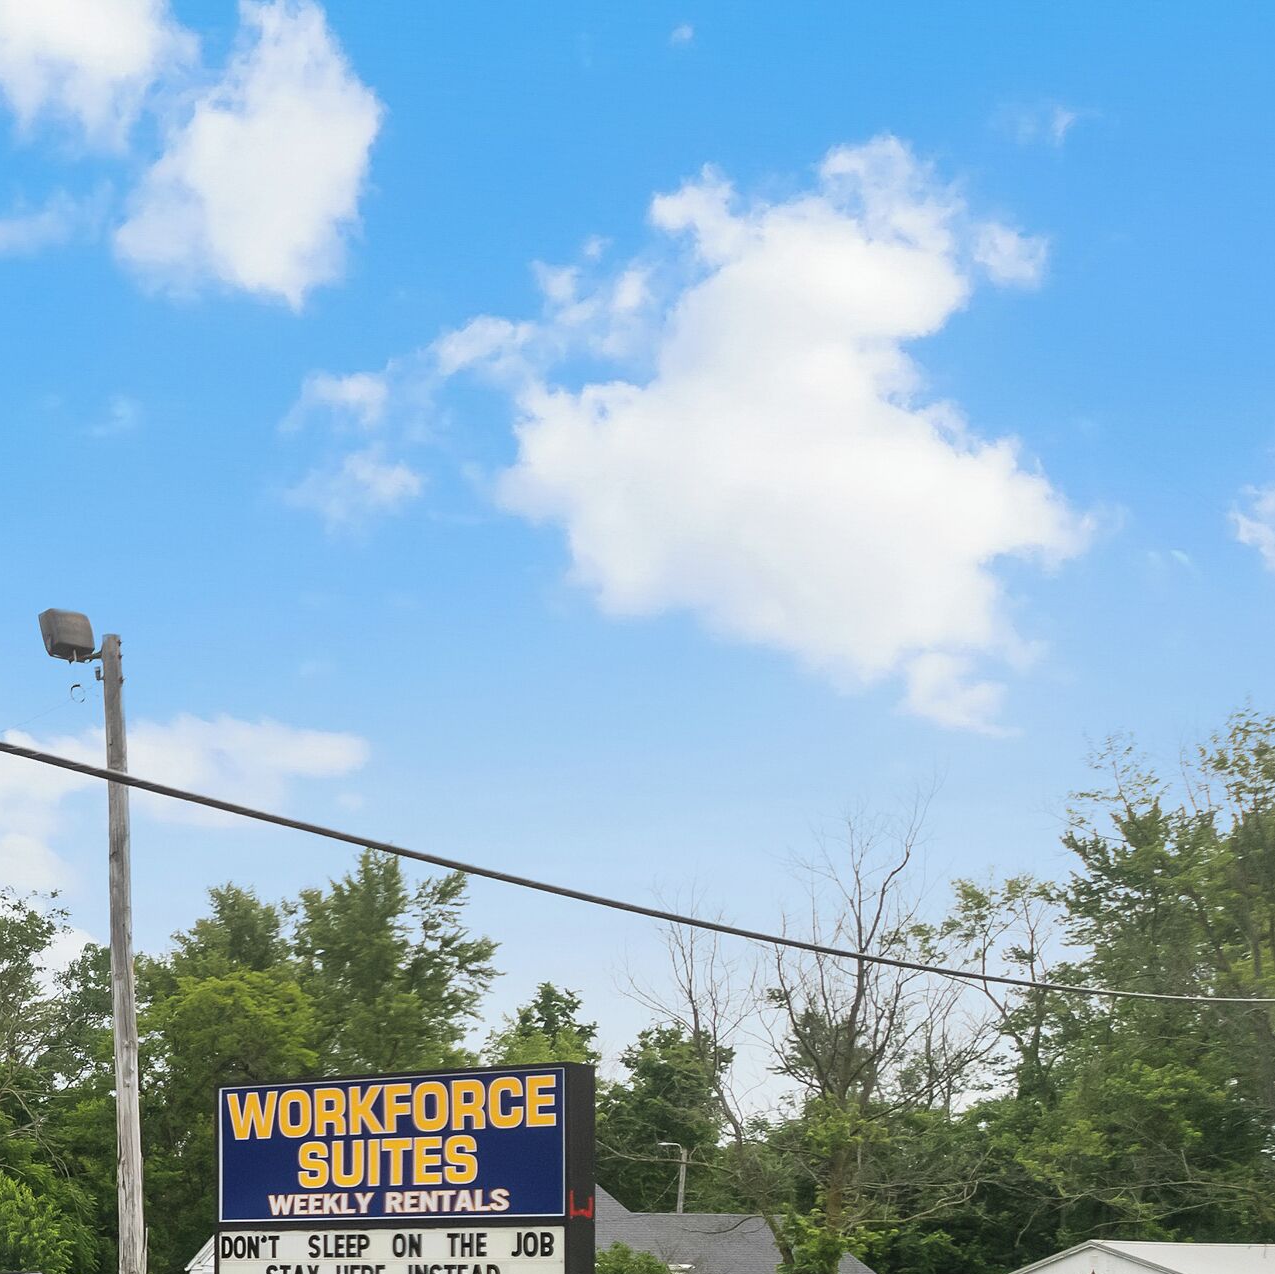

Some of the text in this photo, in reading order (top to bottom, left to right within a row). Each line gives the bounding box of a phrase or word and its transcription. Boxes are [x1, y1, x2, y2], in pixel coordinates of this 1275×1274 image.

[227, 1074, 557, 1140] WORKFORCE
[298, 1135, 478, 1189] SUITES
[268, 1188, 511, 1216] WEEKLY RENTALS
[221, 1232, 555, 1259] DON'T SLEEP ON THE JOB
